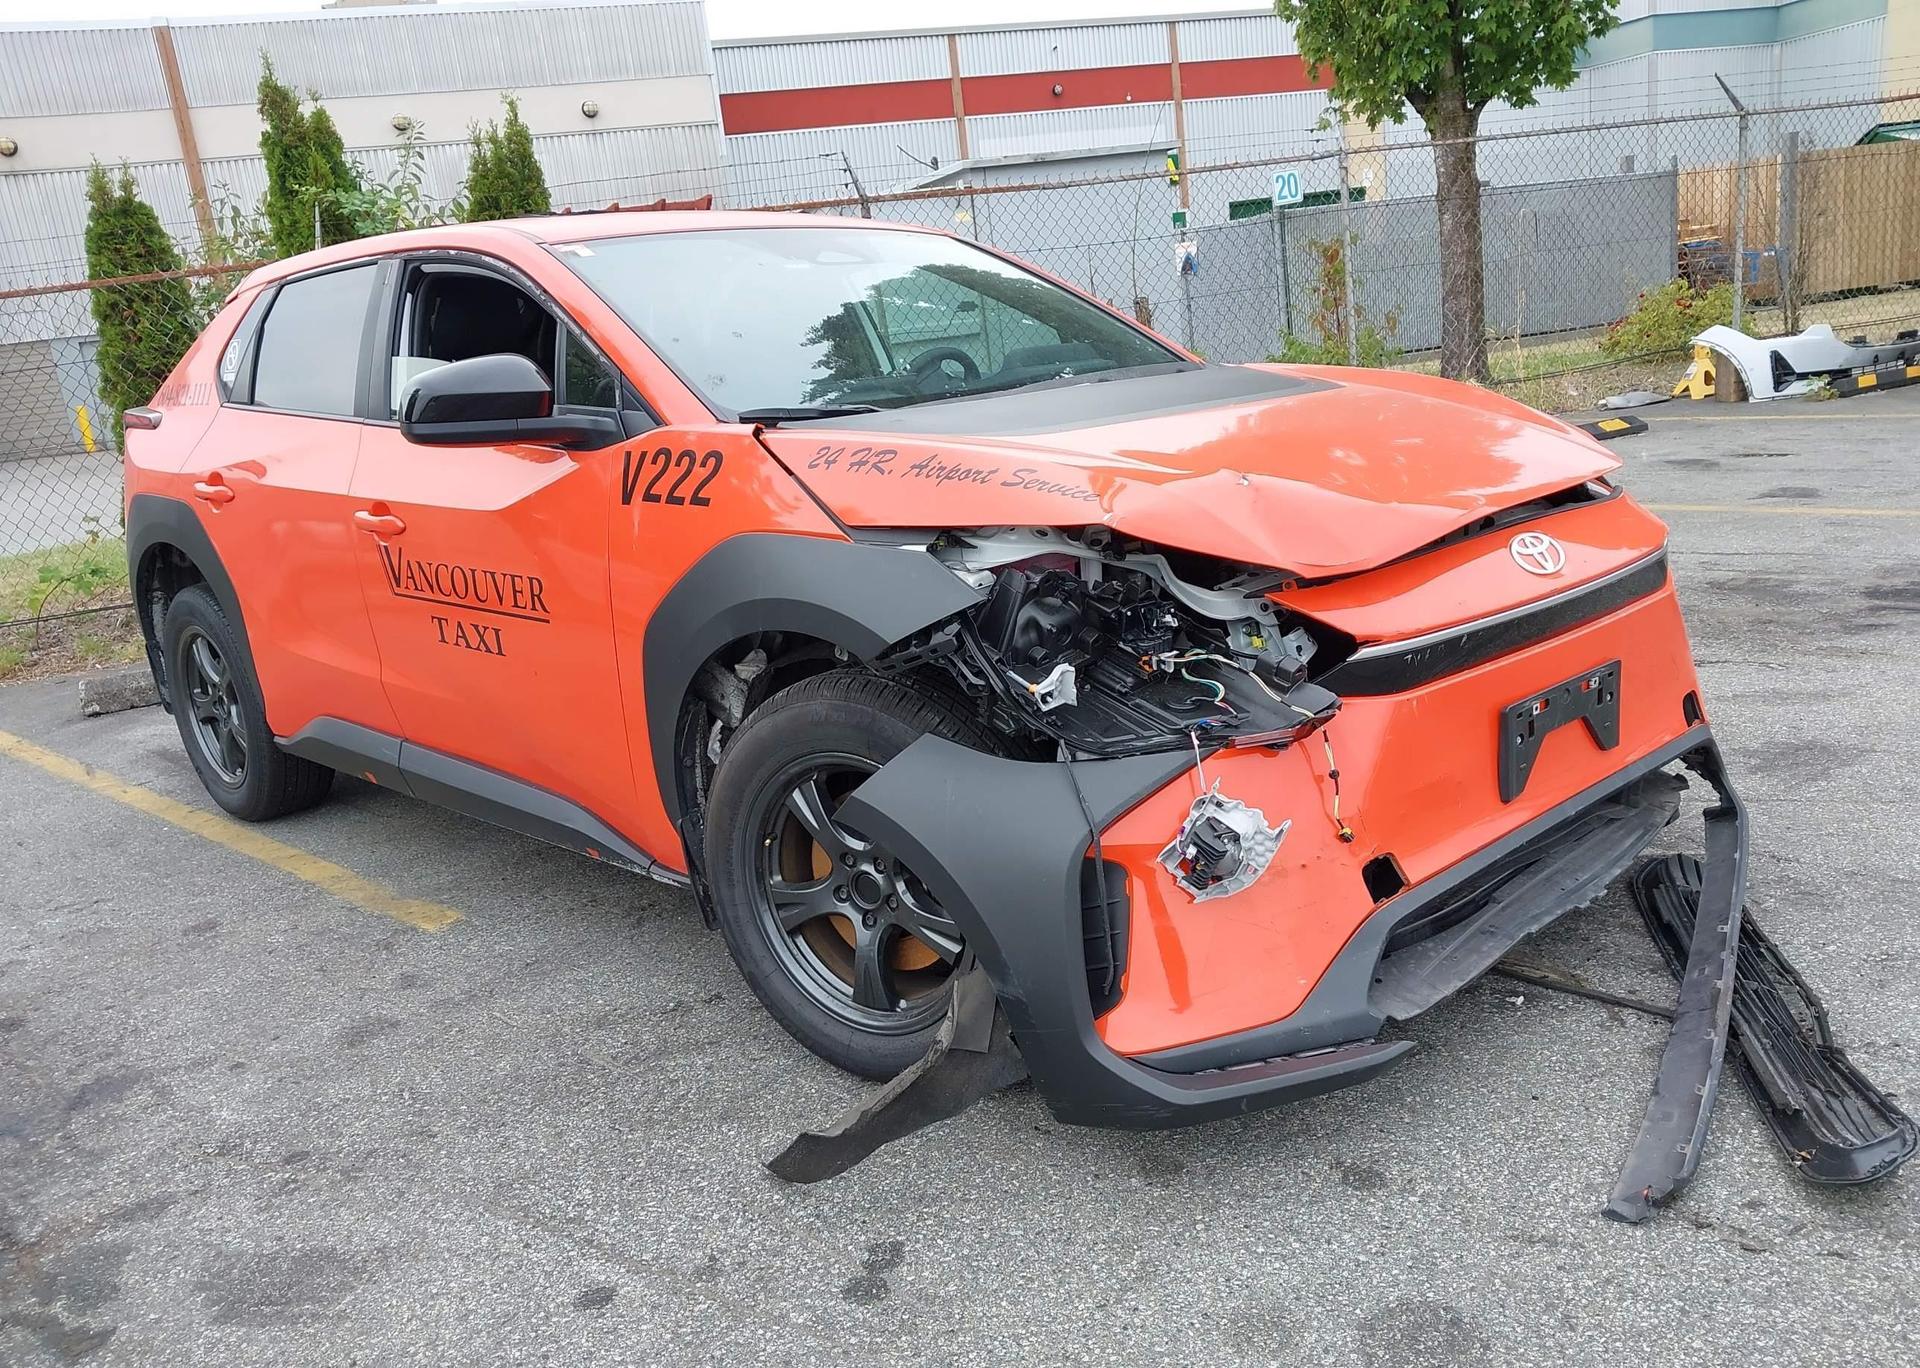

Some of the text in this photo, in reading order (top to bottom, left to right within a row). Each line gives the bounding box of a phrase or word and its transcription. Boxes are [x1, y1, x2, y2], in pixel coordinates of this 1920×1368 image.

[1275, 172, 1299, 201] 20
[621, 447, 724, 507] V222
[807, 446, 1101, 502] 24 HR. Airport Service
[382, 543, 551, 614] VANCOUVER
[430, 615, 507, 657] TAXI
